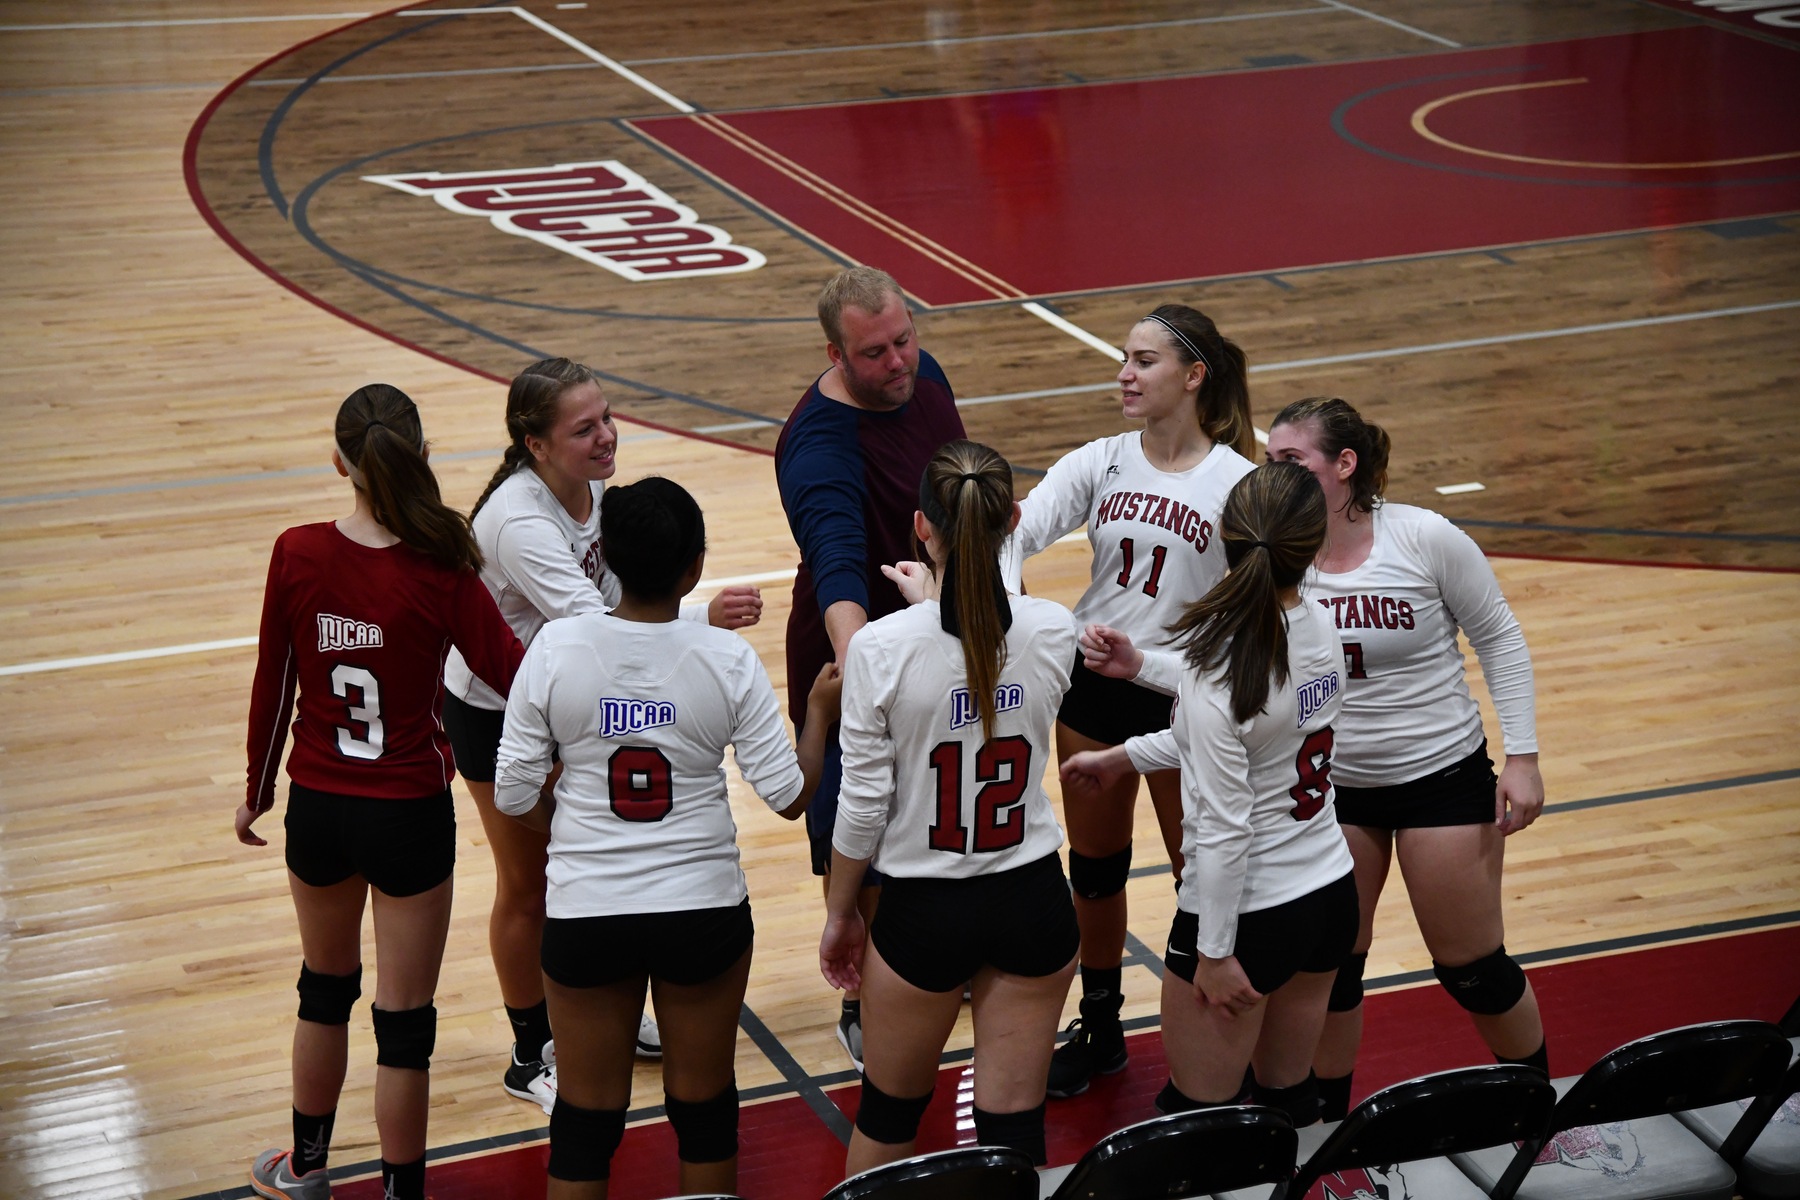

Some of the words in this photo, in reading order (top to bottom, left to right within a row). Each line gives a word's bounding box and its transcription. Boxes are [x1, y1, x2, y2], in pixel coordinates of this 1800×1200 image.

[361, 160, 767, 281] NJCAA
[1095, 491, 1213, 555] MUSTANGS
[1116, 537, 1168, 599] 11
[317, 613, 384, 652] NJCAA
[1318, 595, 1416, 630] TANGS
[329, 662, 386, 762] 3
[600, 698, 676, 738] NJCAA
[950, 684, 1024, 730] NJAA
[1297, 671, 1339, 728] NJCAA
[928, 734, 1032, 855] 12
